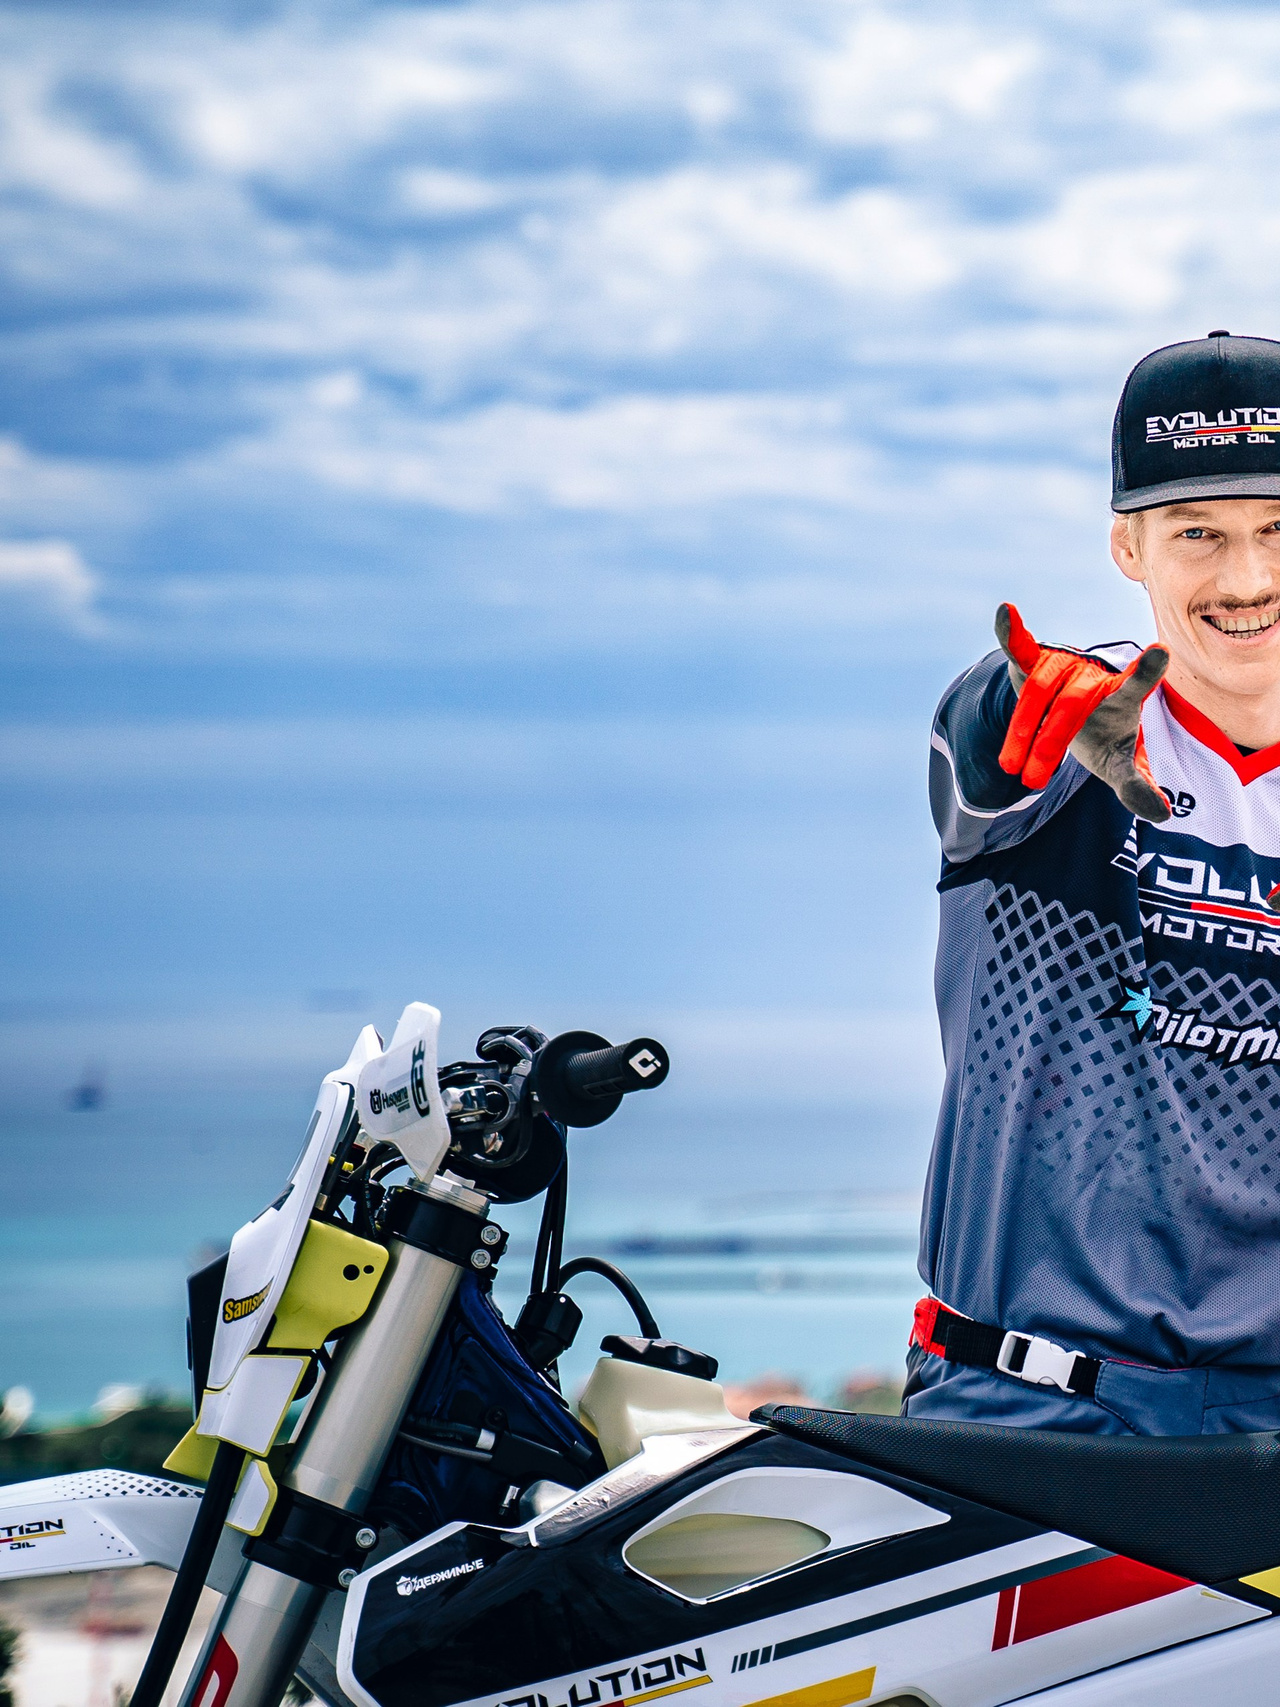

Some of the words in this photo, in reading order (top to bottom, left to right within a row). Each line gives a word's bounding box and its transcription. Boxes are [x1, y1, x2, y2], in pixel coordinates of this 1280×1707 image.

[1173, 434, 1239, 449] MOTOR
[1247, 433, 1275, 444] OIL
[10, 1542, 36, 1550] OIL
